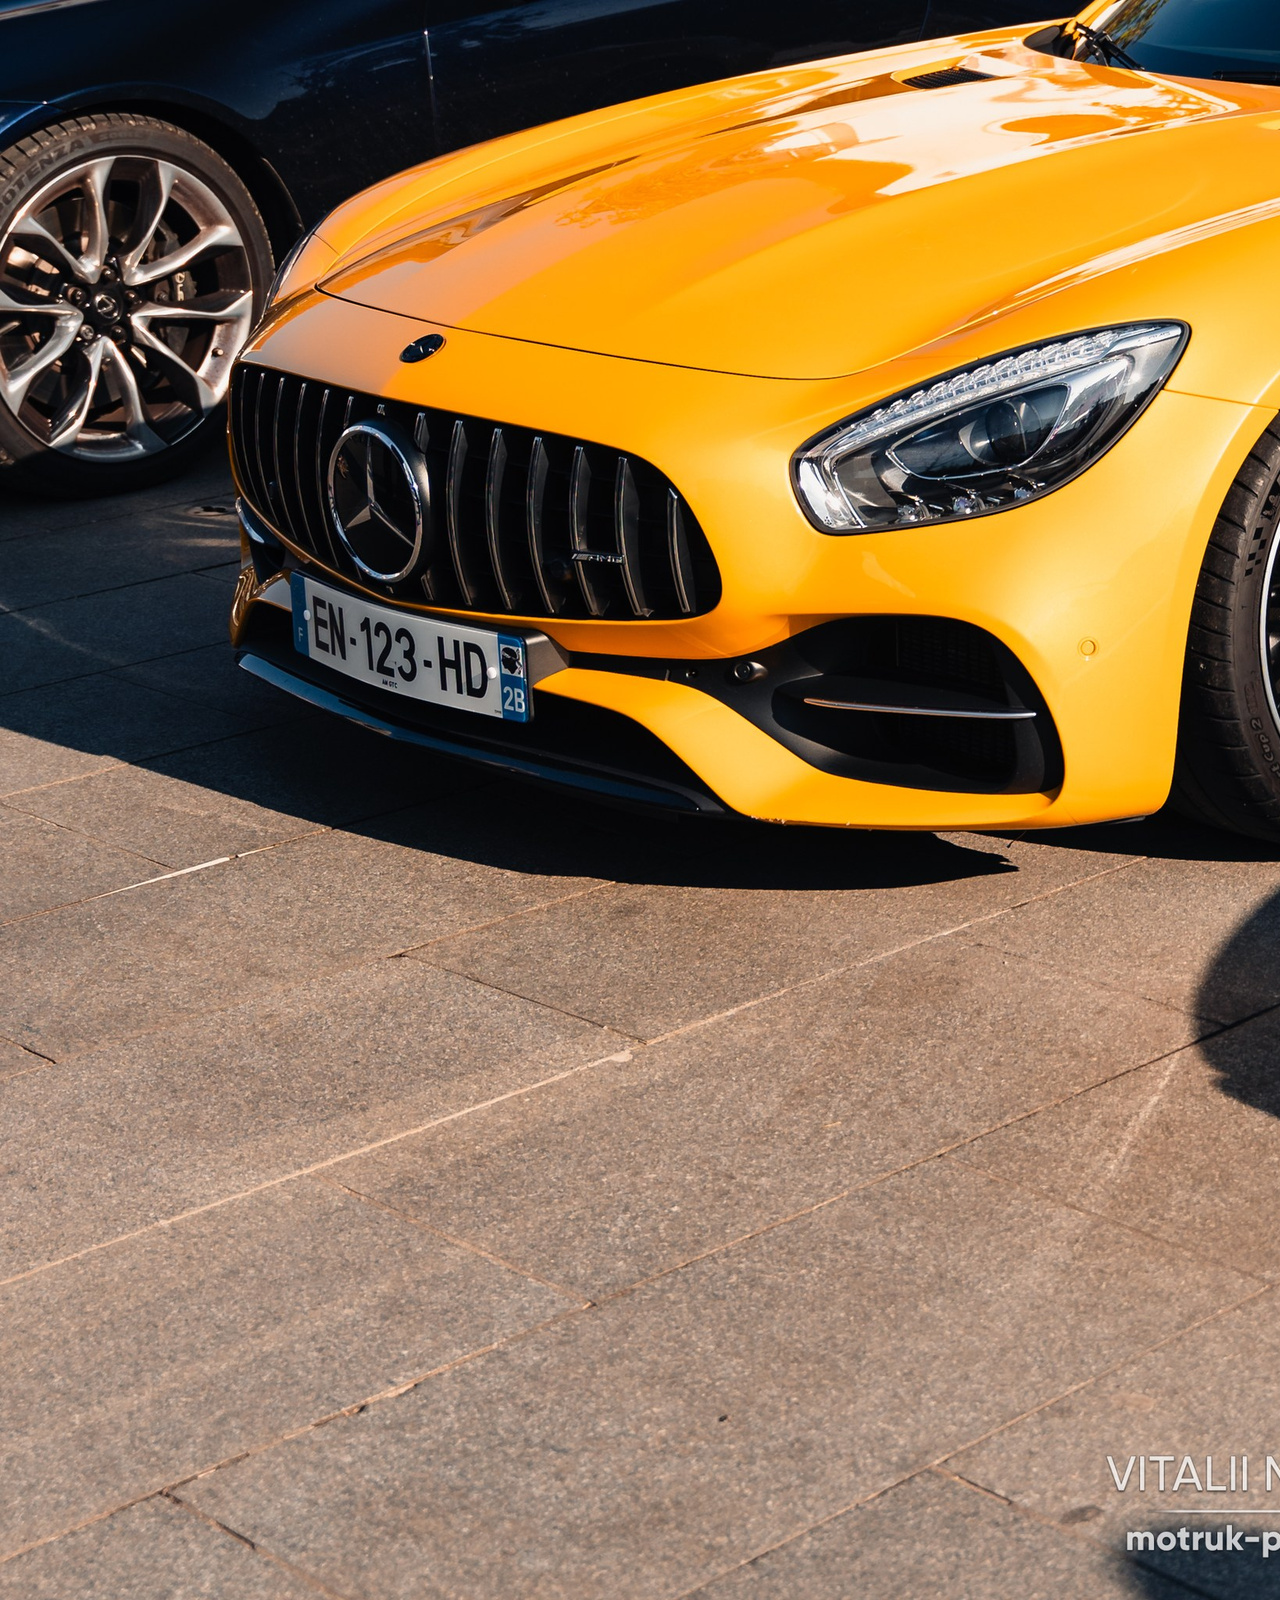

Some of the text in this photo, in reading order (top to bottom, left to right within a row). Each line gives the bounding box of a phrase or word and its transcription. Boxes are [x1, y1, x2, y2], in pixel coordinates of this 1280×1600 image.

[0, 139, 85, 212] OTENZA
[312, 595, 489, 699] EN-123-HD
[503, 685, 525, 714] 2B
[1249, 717, 1264, 731] 2
[1257, 732, 1276, 764] Cup
